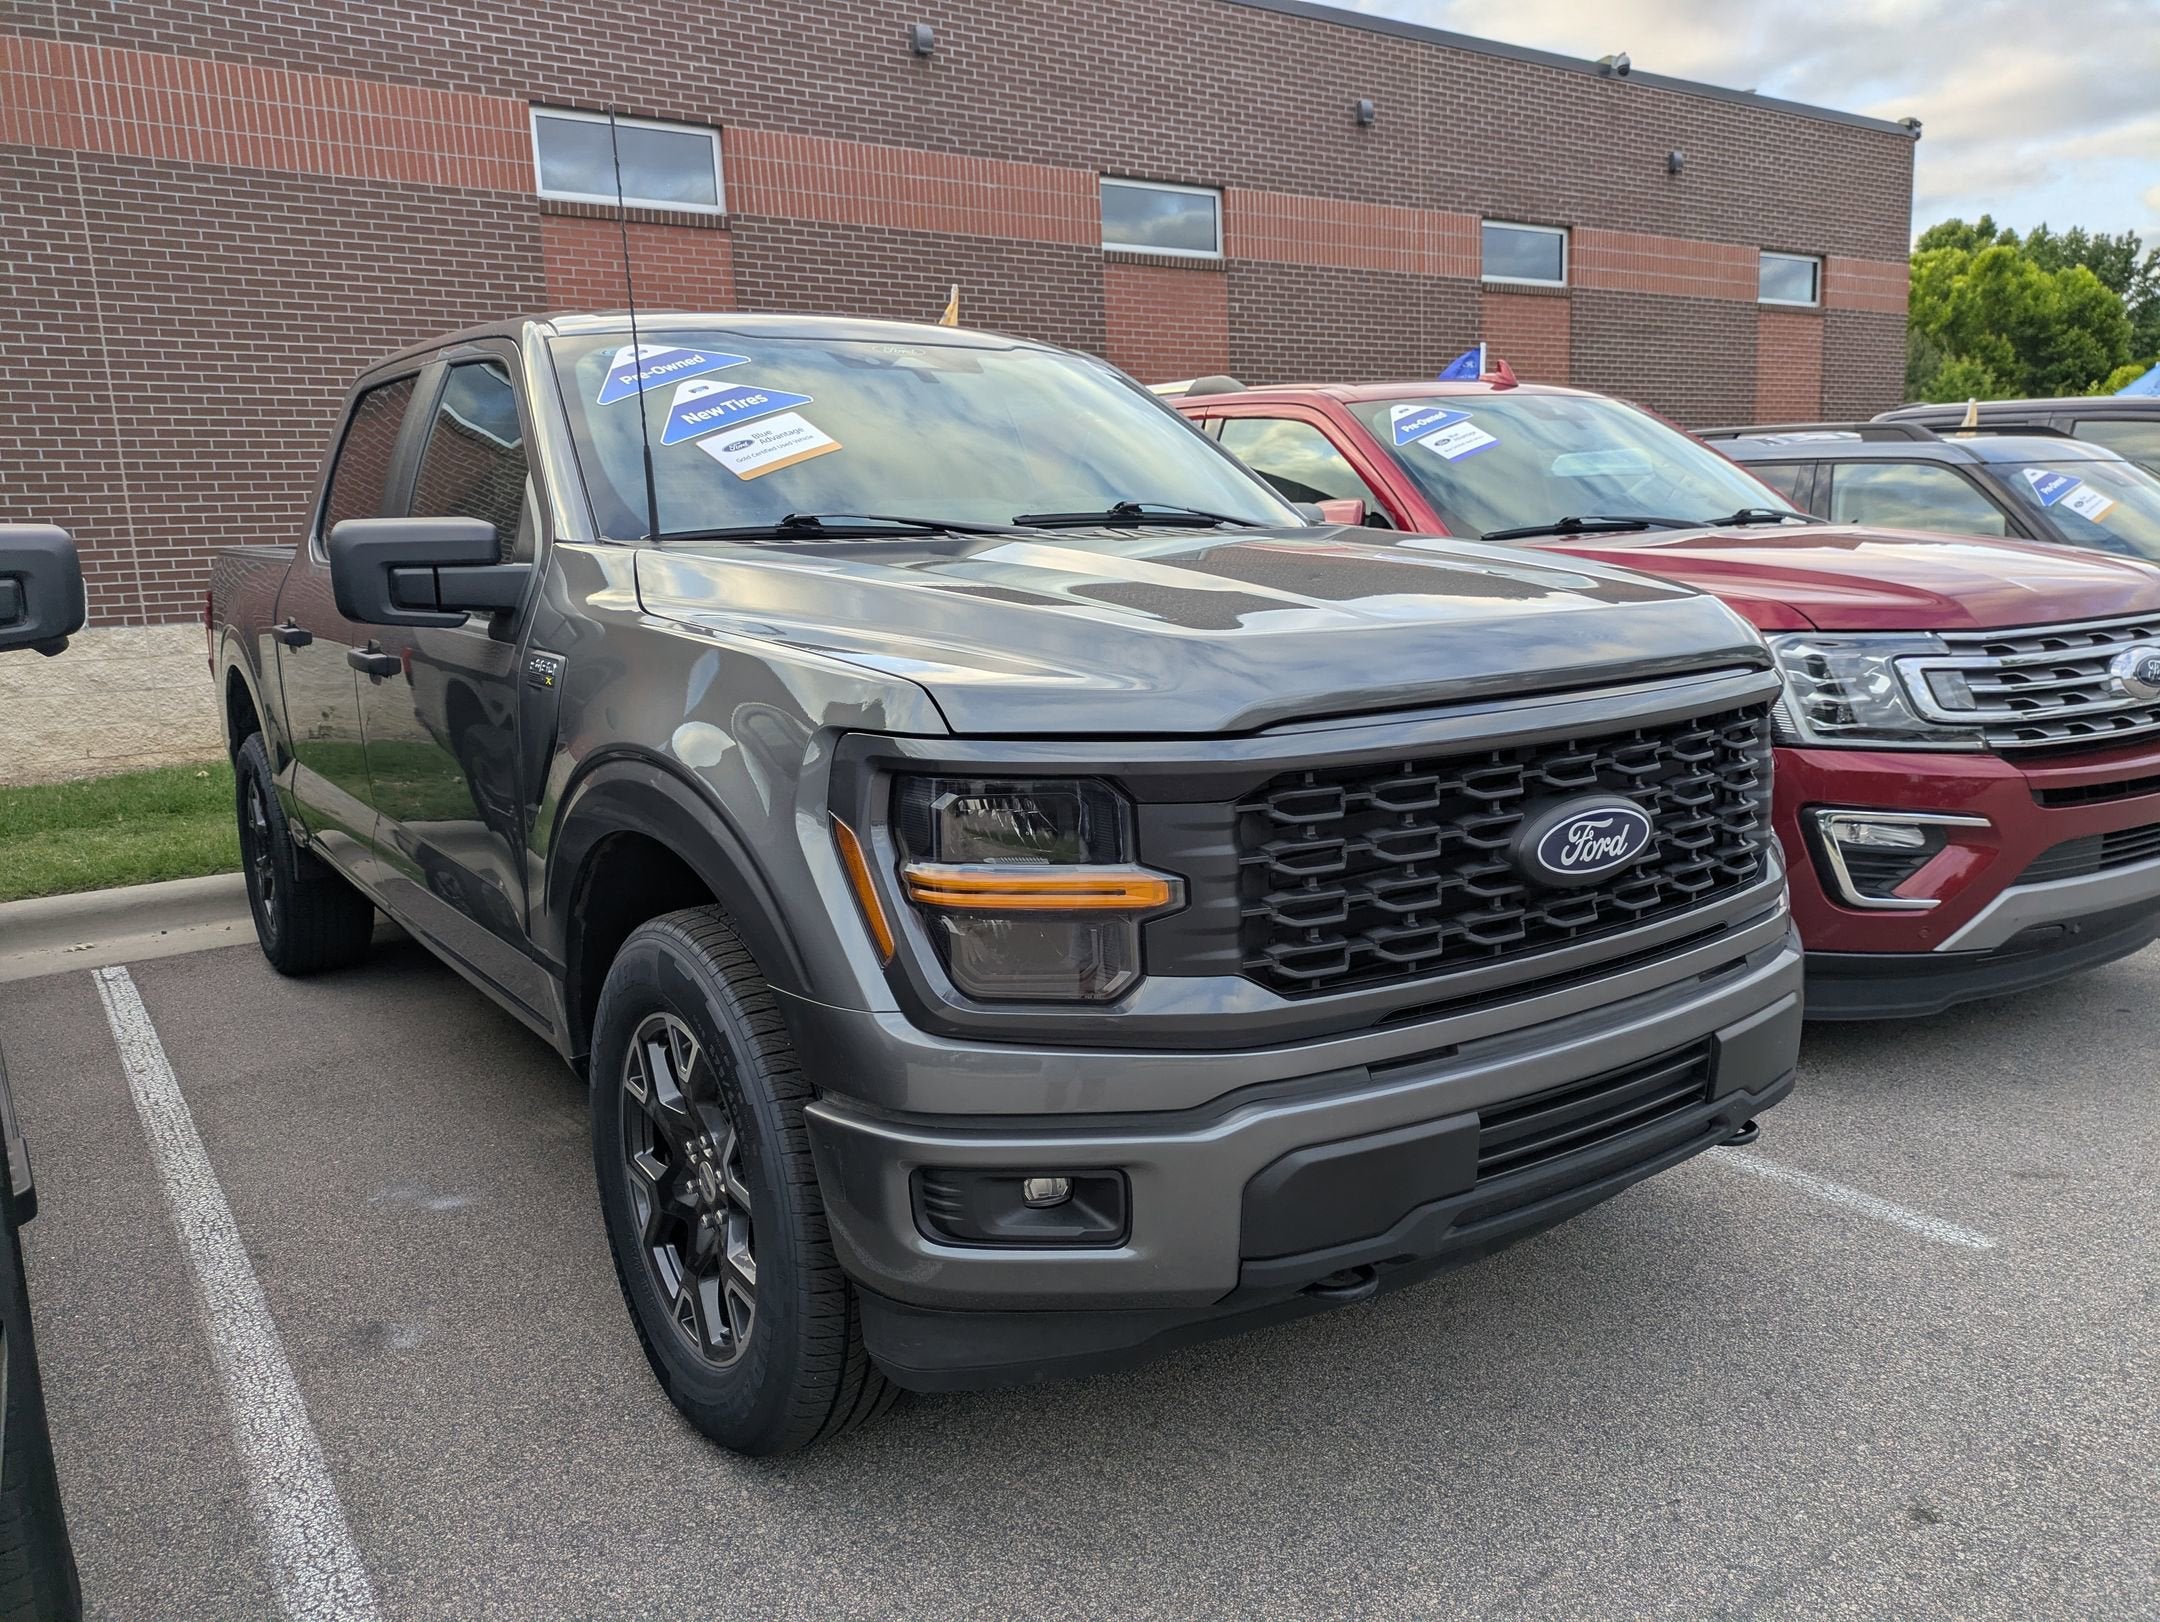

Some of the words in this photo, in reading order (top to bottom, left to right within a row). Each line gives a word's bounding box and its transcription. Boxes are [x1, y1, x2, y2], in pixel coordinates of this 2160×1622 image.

[619, 354, 707, 385] Pre-Owned
[680, 405, 725, 425] New
[720, 394, 769, 412] Tires
[751, 430, 773, 440] Blue
[760, 428, 805, 445] Advantage
[1560, 818, 1630, 866] Ford
